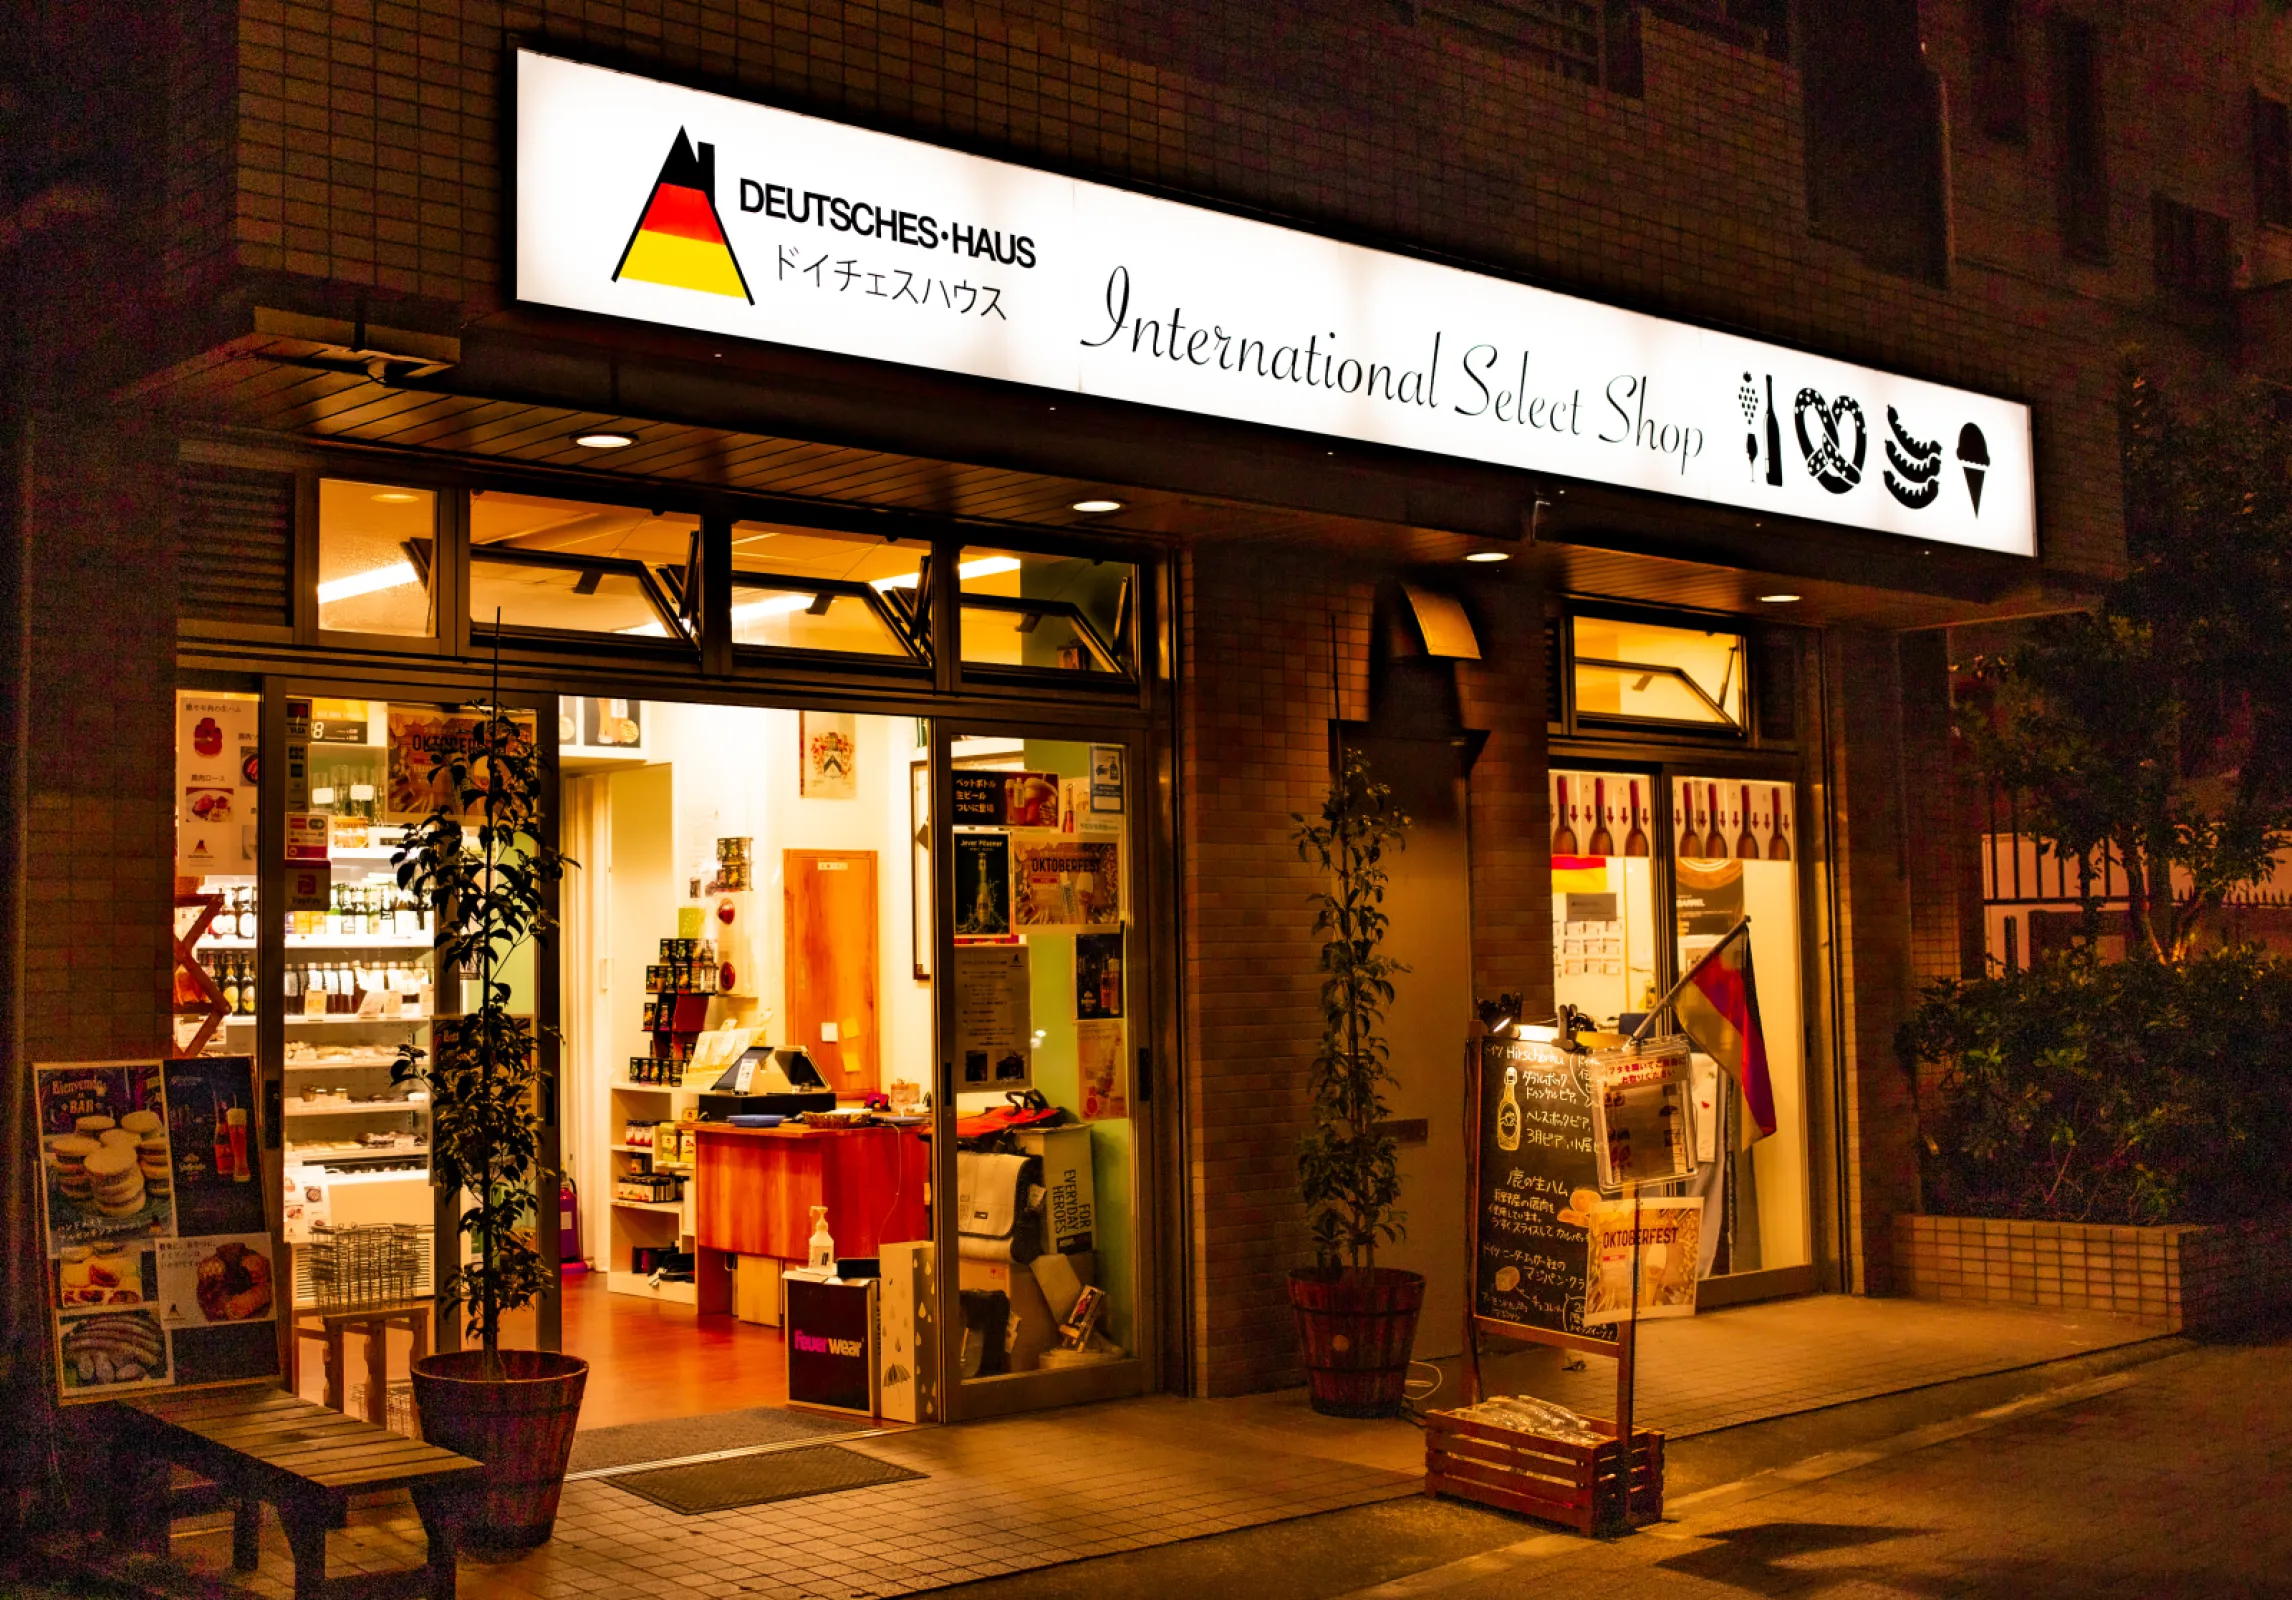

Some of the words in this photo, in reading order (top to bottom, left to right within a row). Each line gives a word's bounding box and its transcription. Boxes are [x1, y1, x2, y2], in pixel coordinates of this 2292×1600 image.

[778, 244, 1007, 320] ドイチェスハウス
[1080, 265, 1441, 409] International
[1454, 343, 1581, 437] Select
[1598, 374, 1703, 475] Shop
[955, 778, 997, 789] ペットボトル
[955, 790, 987, 801] 生ビール
[1032, 857, 1101, 873] OKTOBERFEST
[1052, 1186, 1067, 1234] HEROES
[1063, 1169, 1080, 1231] EVERYDAY
[1079, 1203, 1091, 1228] FOR
[1602, 1227, 1679, 1249] OKTOBERFEST
